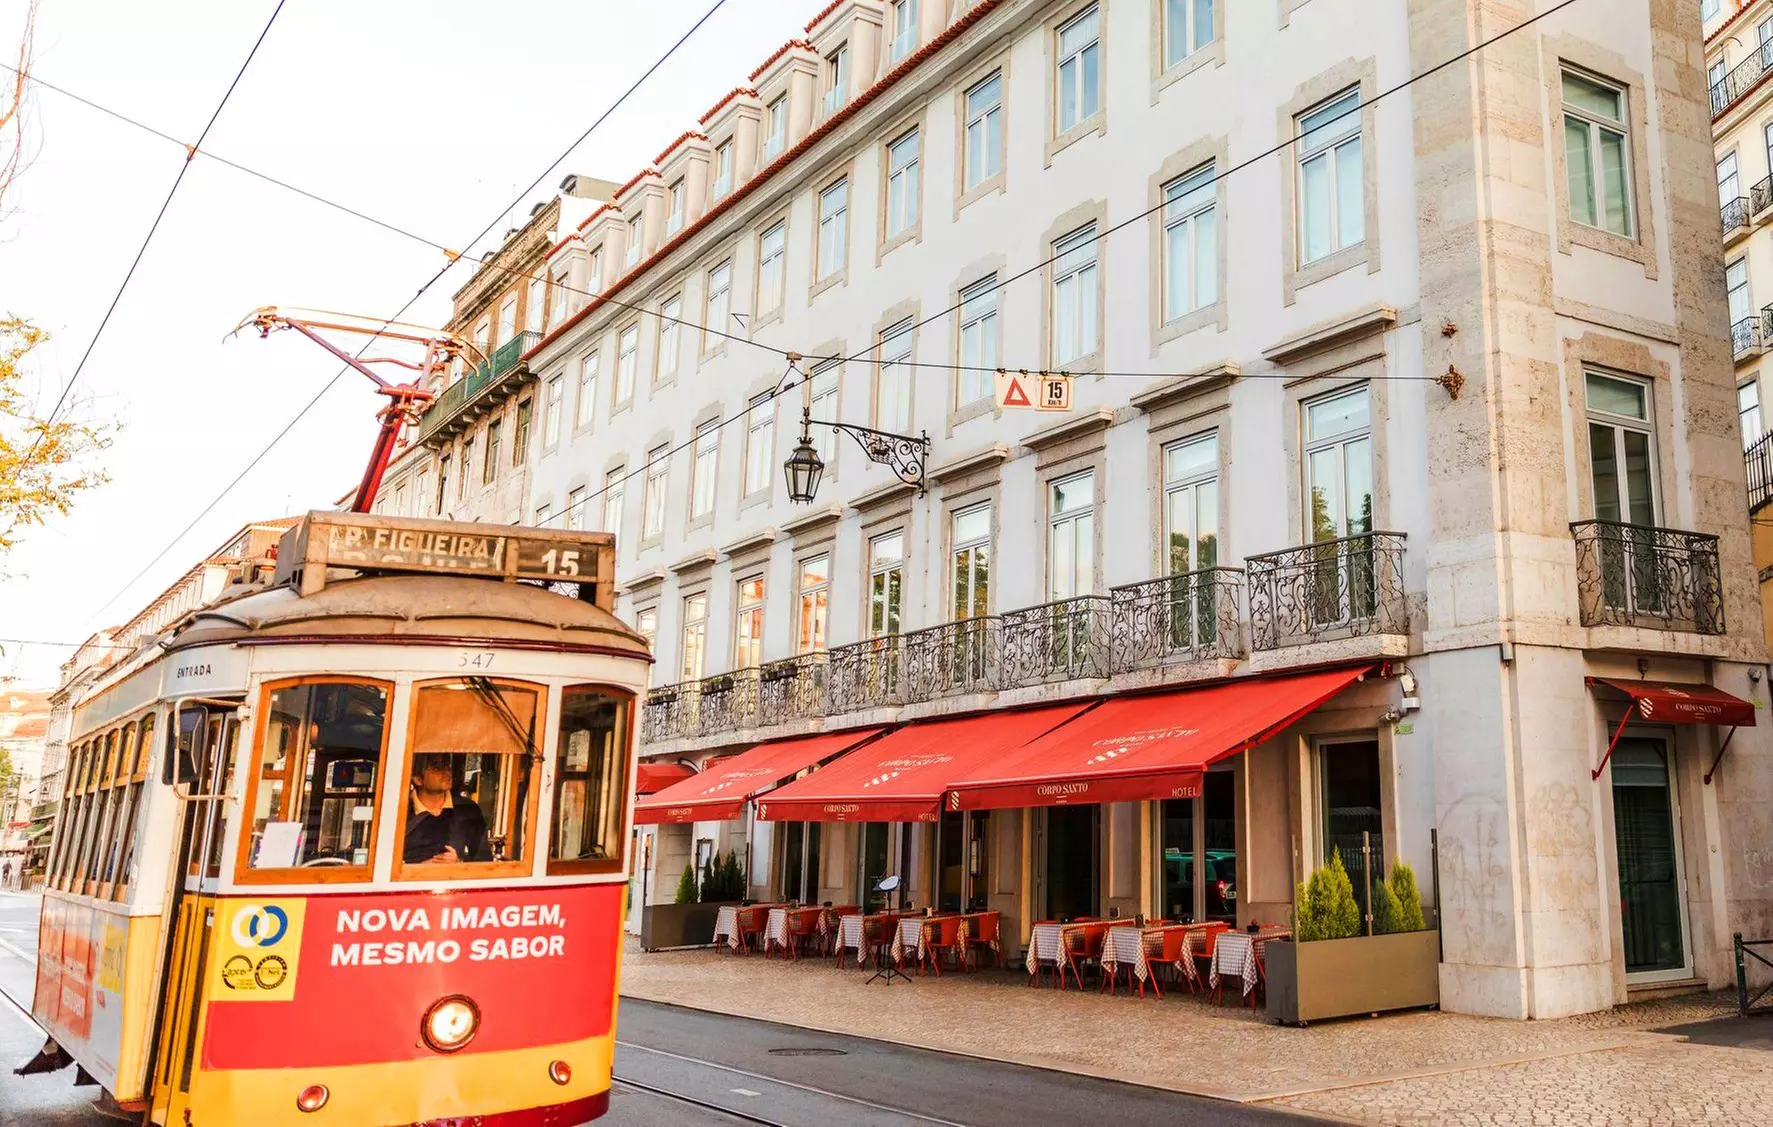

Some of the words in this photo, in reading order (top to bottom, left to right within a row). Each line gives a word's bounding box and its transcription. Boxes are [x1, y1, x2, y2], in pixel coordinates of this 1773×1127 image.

[1048, 382, 1062, 398] 15
[373, 528, 489, 559] FIGUEIRA
[541, 548, 580, 577] 15
[457, 652, 495, 668] 547
[177, 664, 212, 679] ENTRADA
[1037, 784, 1062, 796] CORPO
[1062, 783, 1089, 794] SANTO
[1171, 787, 1197, 797] HOTEL
[918, 812, 936, 821] HOTEL
[336, 908, 431, 933] NOVA
[440, 904, 567, 930] IMAGEM,
[330, 940, 461, 966] MESMO
[469, 935, 565, 961] SABOR
